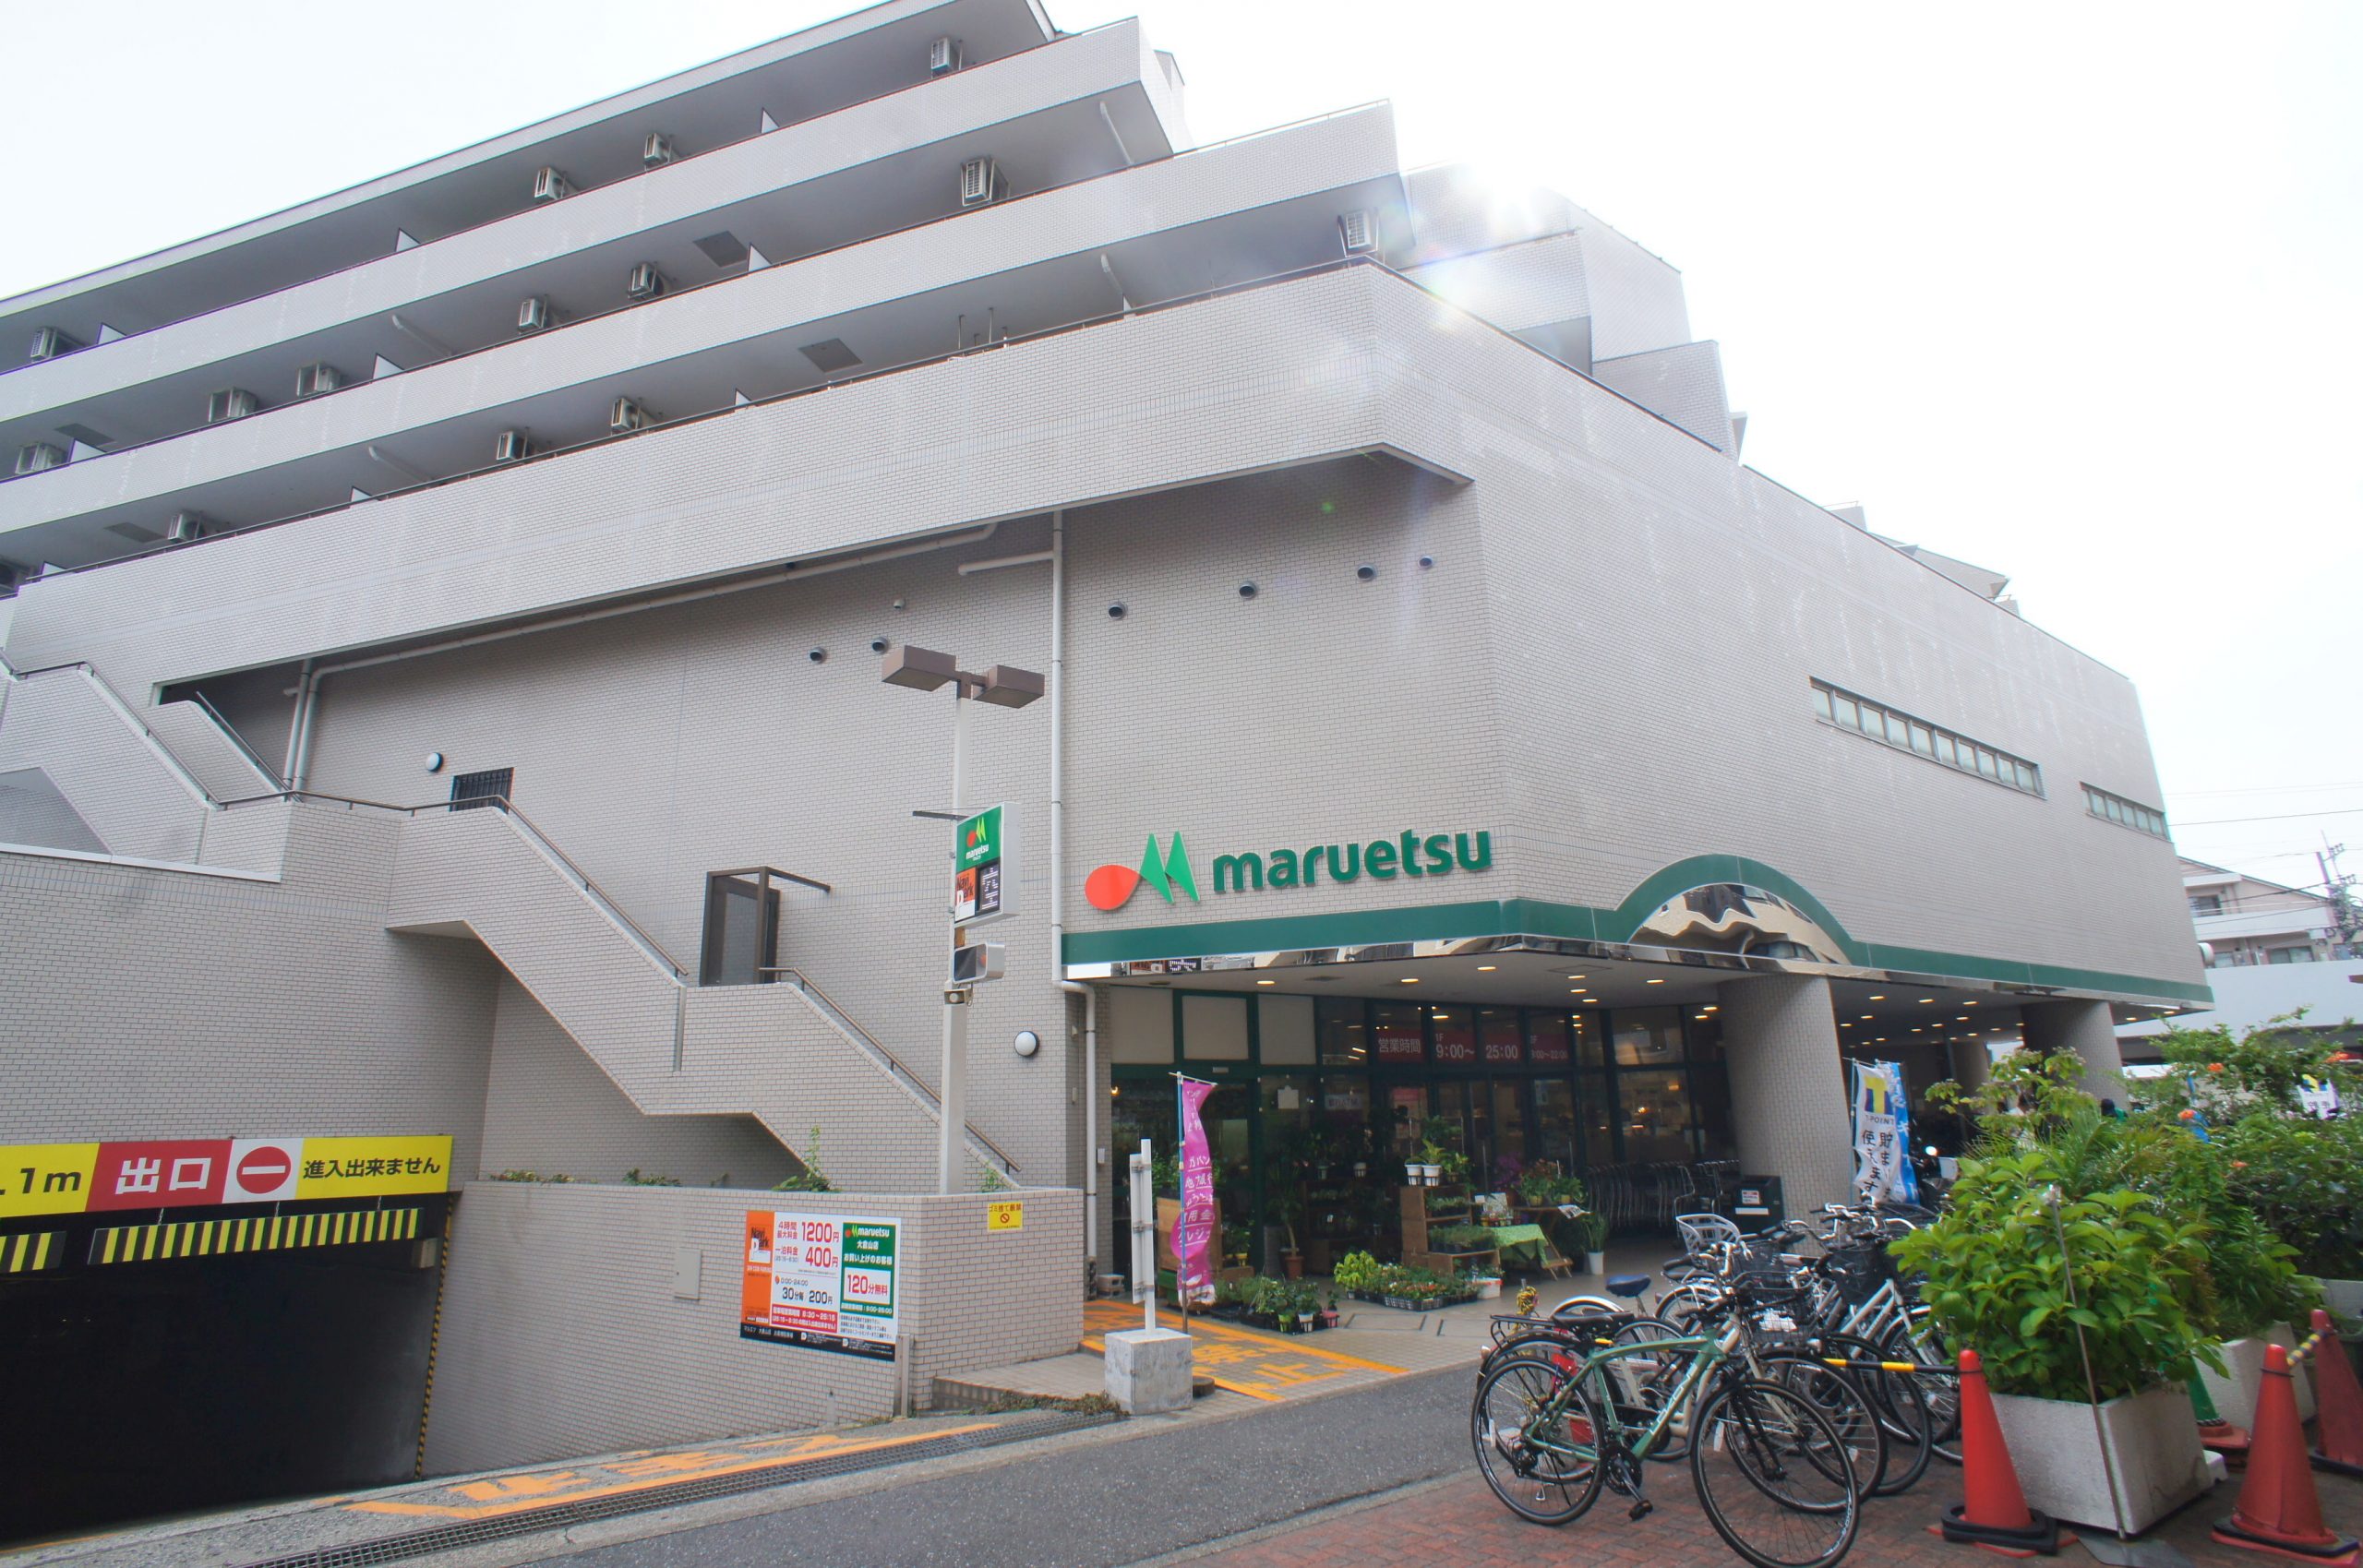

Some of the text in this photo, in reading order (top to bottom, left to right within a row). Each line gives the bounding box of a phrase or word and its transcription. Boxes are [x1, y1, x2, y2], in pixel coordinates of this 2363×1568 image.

[966, 844, 990, 860] maruetsu
[1212, 829, 1492, 893] maruetsu
[1377, 1037, 1421, 1055] 営業時間
[1435, 1033, 1445, 1042] 1F
[1485, 1044, 1518, 1059] 25:00
[114, 1156, 212, 1195] 出口
[303, 1157, 441, 1179] 進入出来ません
[778, 1221, 798, 1231] 4時間
[801, 1221, 840, 1243] 1200円
[858, 1227, 890, 1238] maruetsu
[805, 1246, 839, 1268] 400円
[847, 1274, 888, 1296] 120分無料
[809, 1289, 834, 1305] 200円
